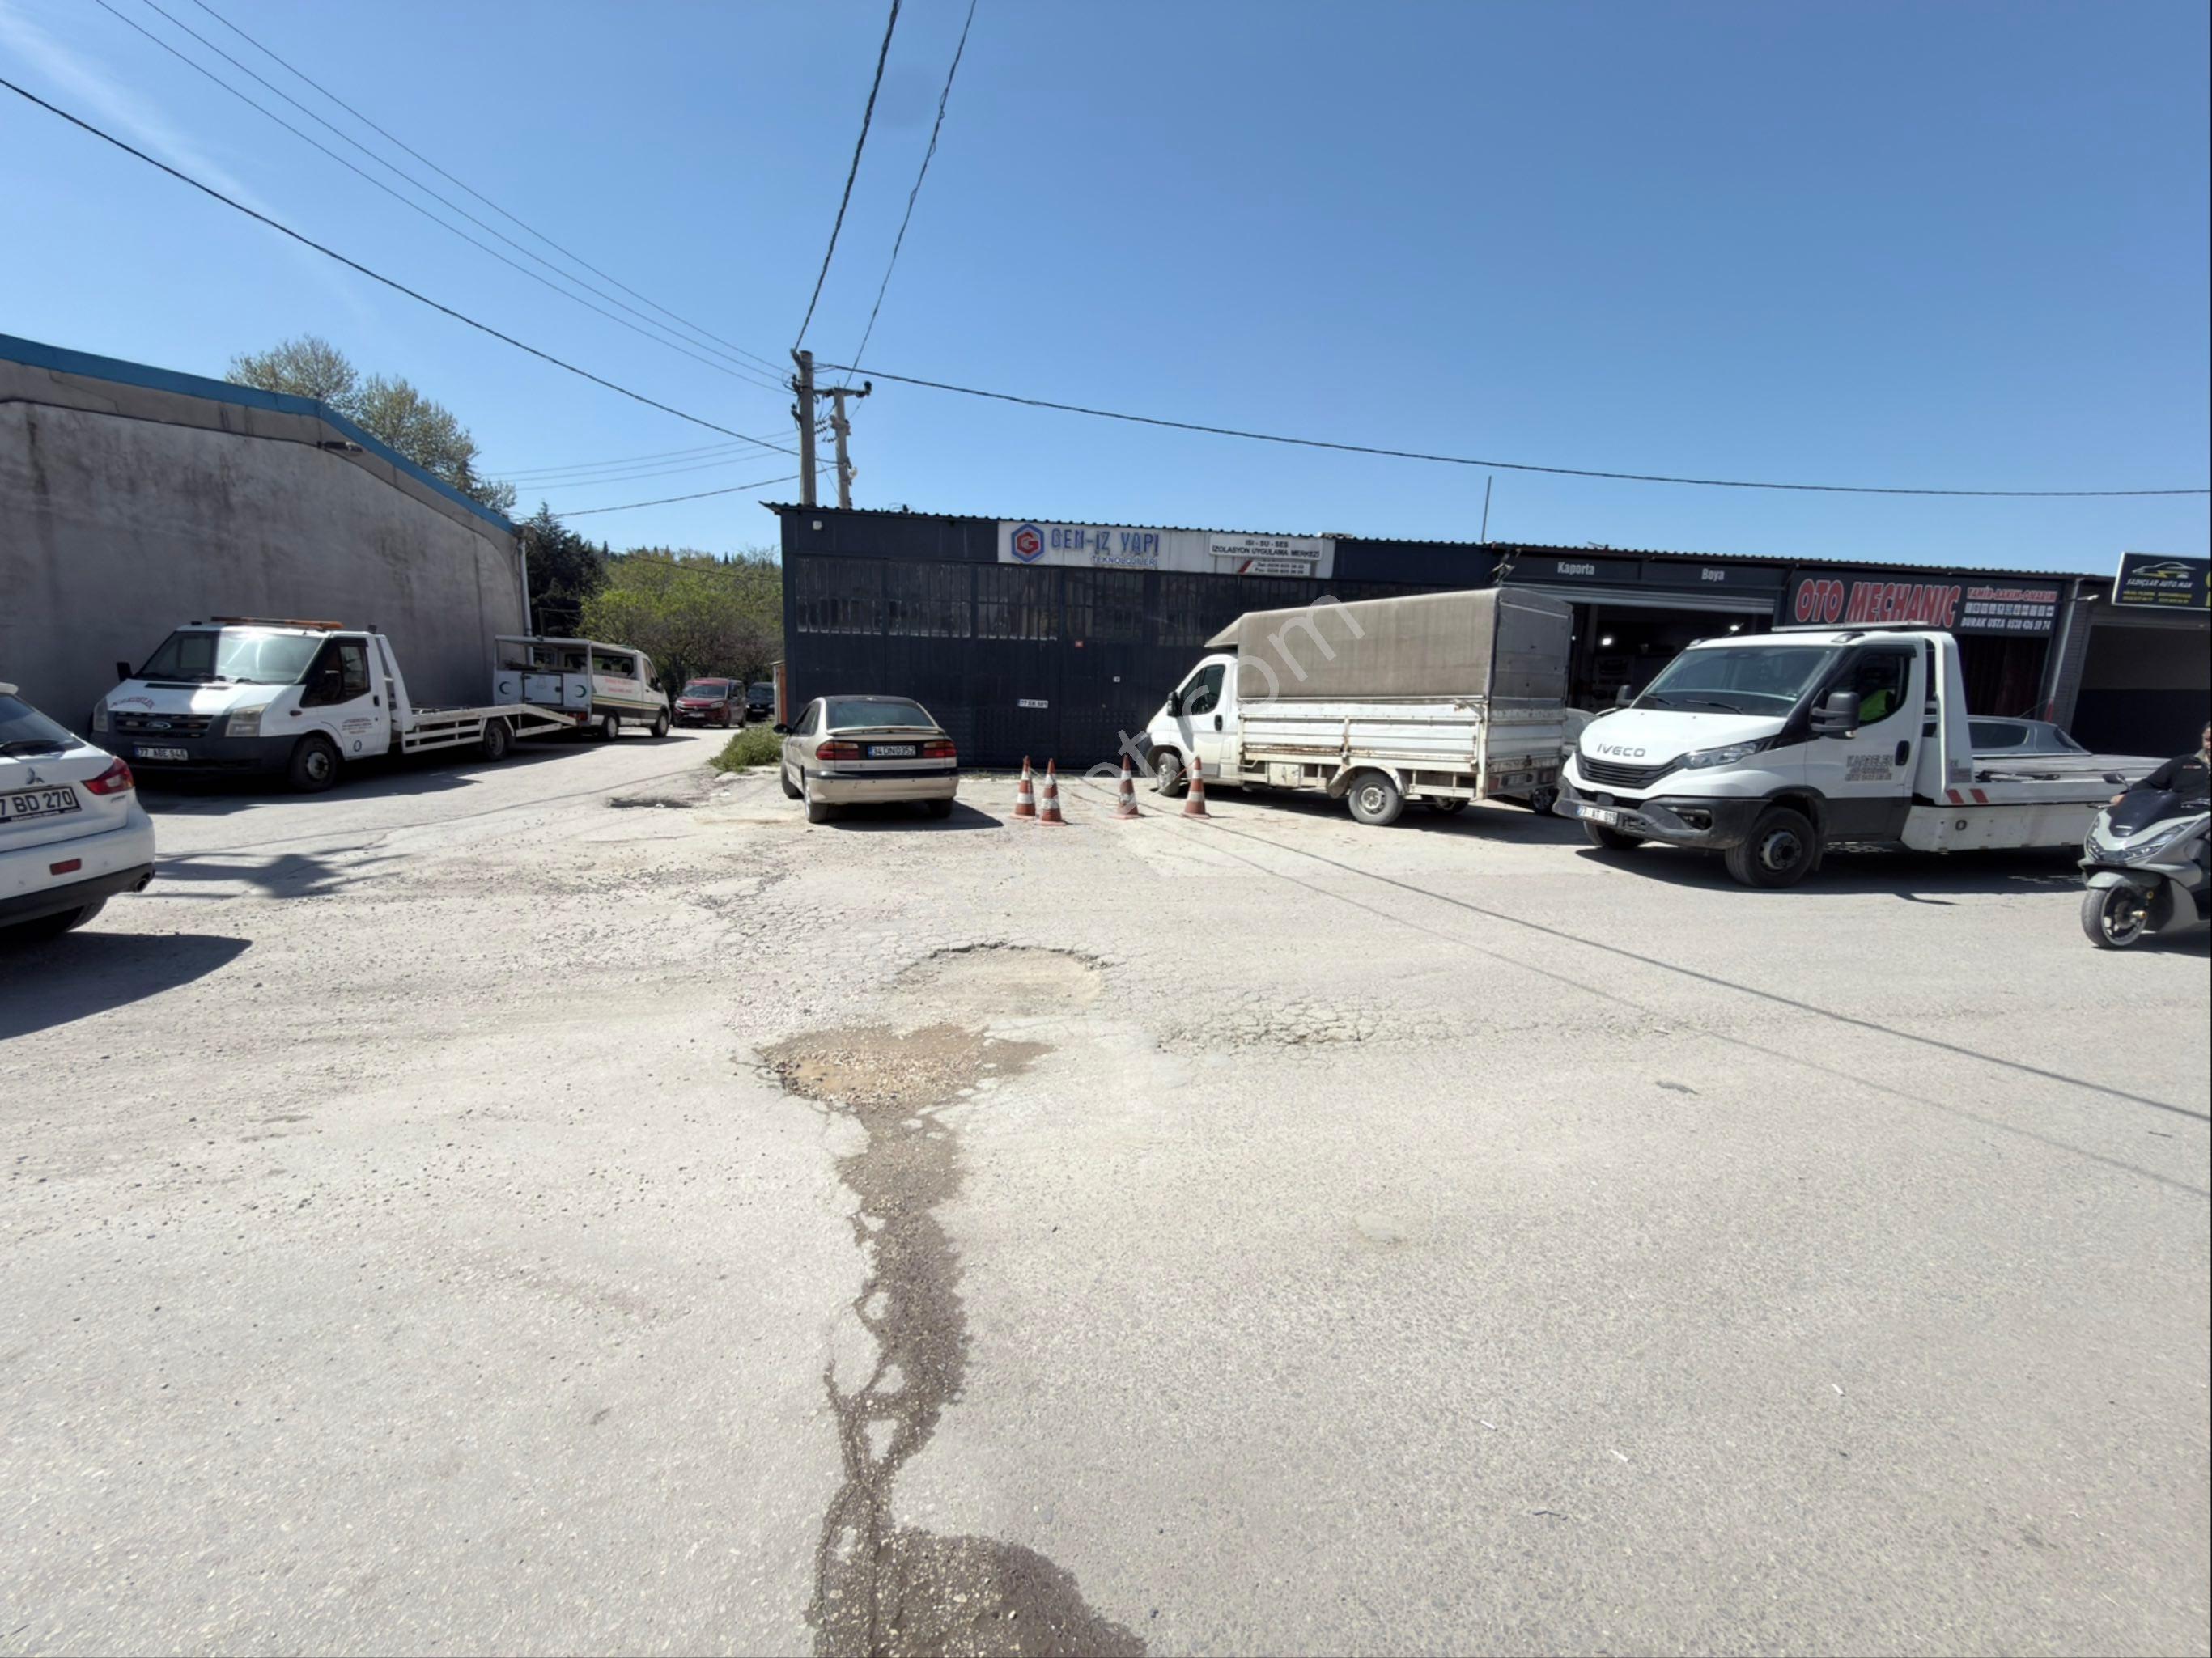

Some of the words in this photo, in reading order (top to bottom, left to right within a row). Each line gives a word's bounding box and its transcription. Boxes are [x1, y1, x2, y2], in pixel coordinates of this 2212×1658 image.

[1121, 532, 1159, 553] YAPI
[1557, 562, 1594, 575] Kaporta
[1701, 568, 1725, 581] Boya
[1795, 579, 1844, 623] OTO
[1844, 581, 1962, 628] MECHANIC
[1597, 743, 1646, 757] IVECO
[12, 795, 40, 813] BD
[43, 790, 73, 808] 270
